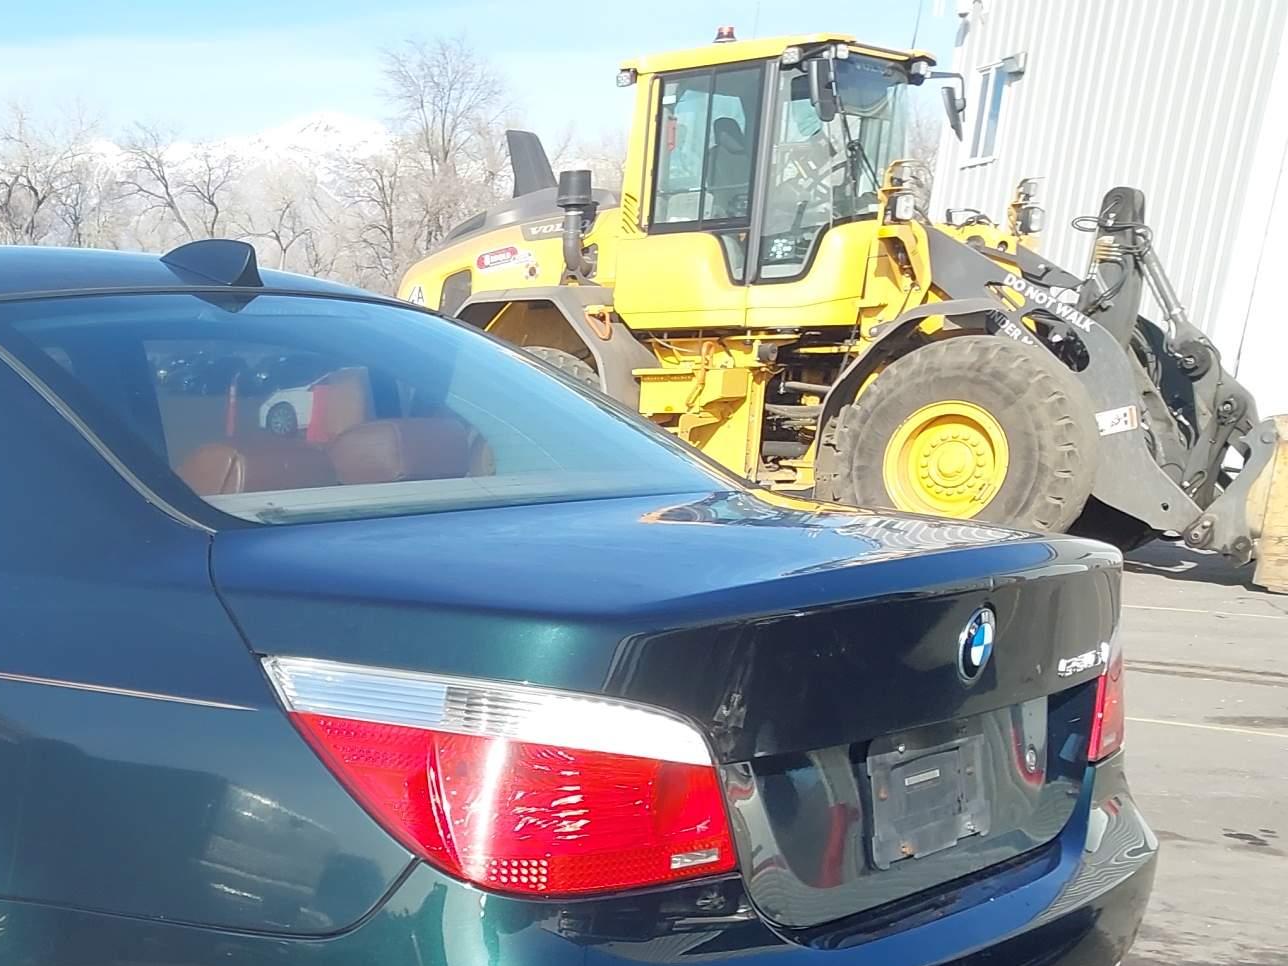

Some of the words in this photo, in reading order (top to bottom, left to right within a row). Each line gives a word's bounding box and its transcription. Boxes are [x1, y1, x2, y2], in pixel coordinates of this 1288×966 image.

[528, 219, 591, 236] VOLO
[1003, 273, 1026, 291] DO
[1024, 286, 1056, 309] NOT
[1055, 302, 1095, 333] WALK
